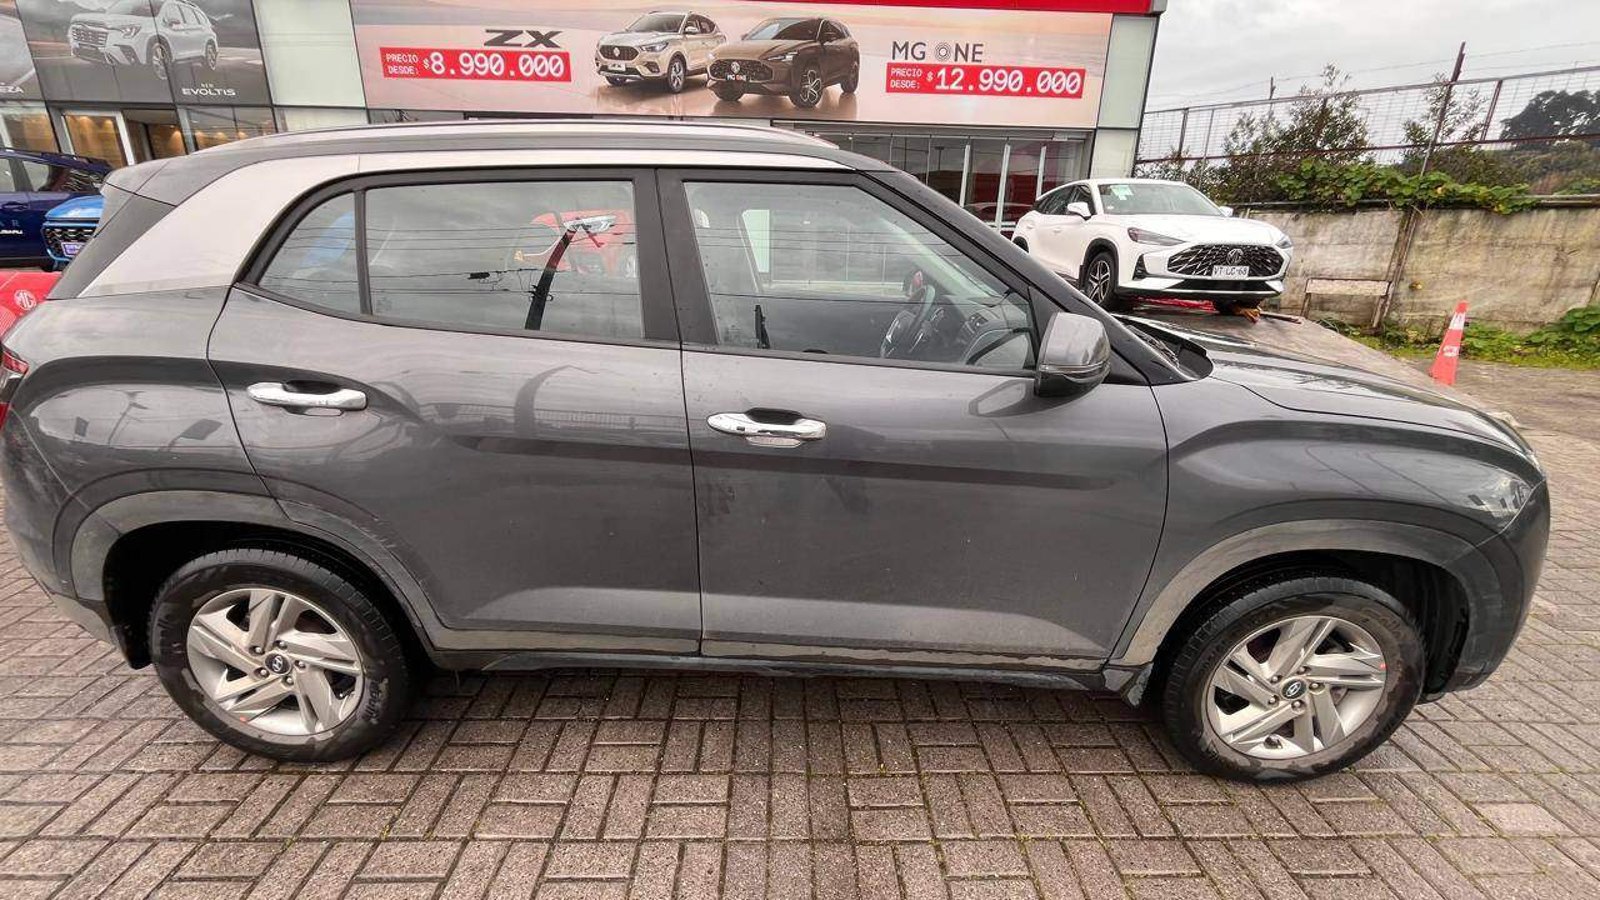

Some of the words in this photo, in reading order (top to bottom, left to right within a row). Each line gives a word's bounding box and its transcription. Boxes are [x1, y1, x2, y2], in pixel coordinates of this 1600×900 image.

[484, 29, 563, 48] ZX
[891, 41, 926, 60] MG
[934, 43, 985, 63] ONE
[386, 53, 419, 63] PRECIO
[423, 51, 565, 77] $8.990.000
[388, 65, 420, 75] DESDE:
[890, 67, 923, 78] PRECIO
[890, 79, 921, 89] DESDE:
[926, 67, 1082, 94] $12.990.000
[181, 88, 236, 96] EVOLTIS
